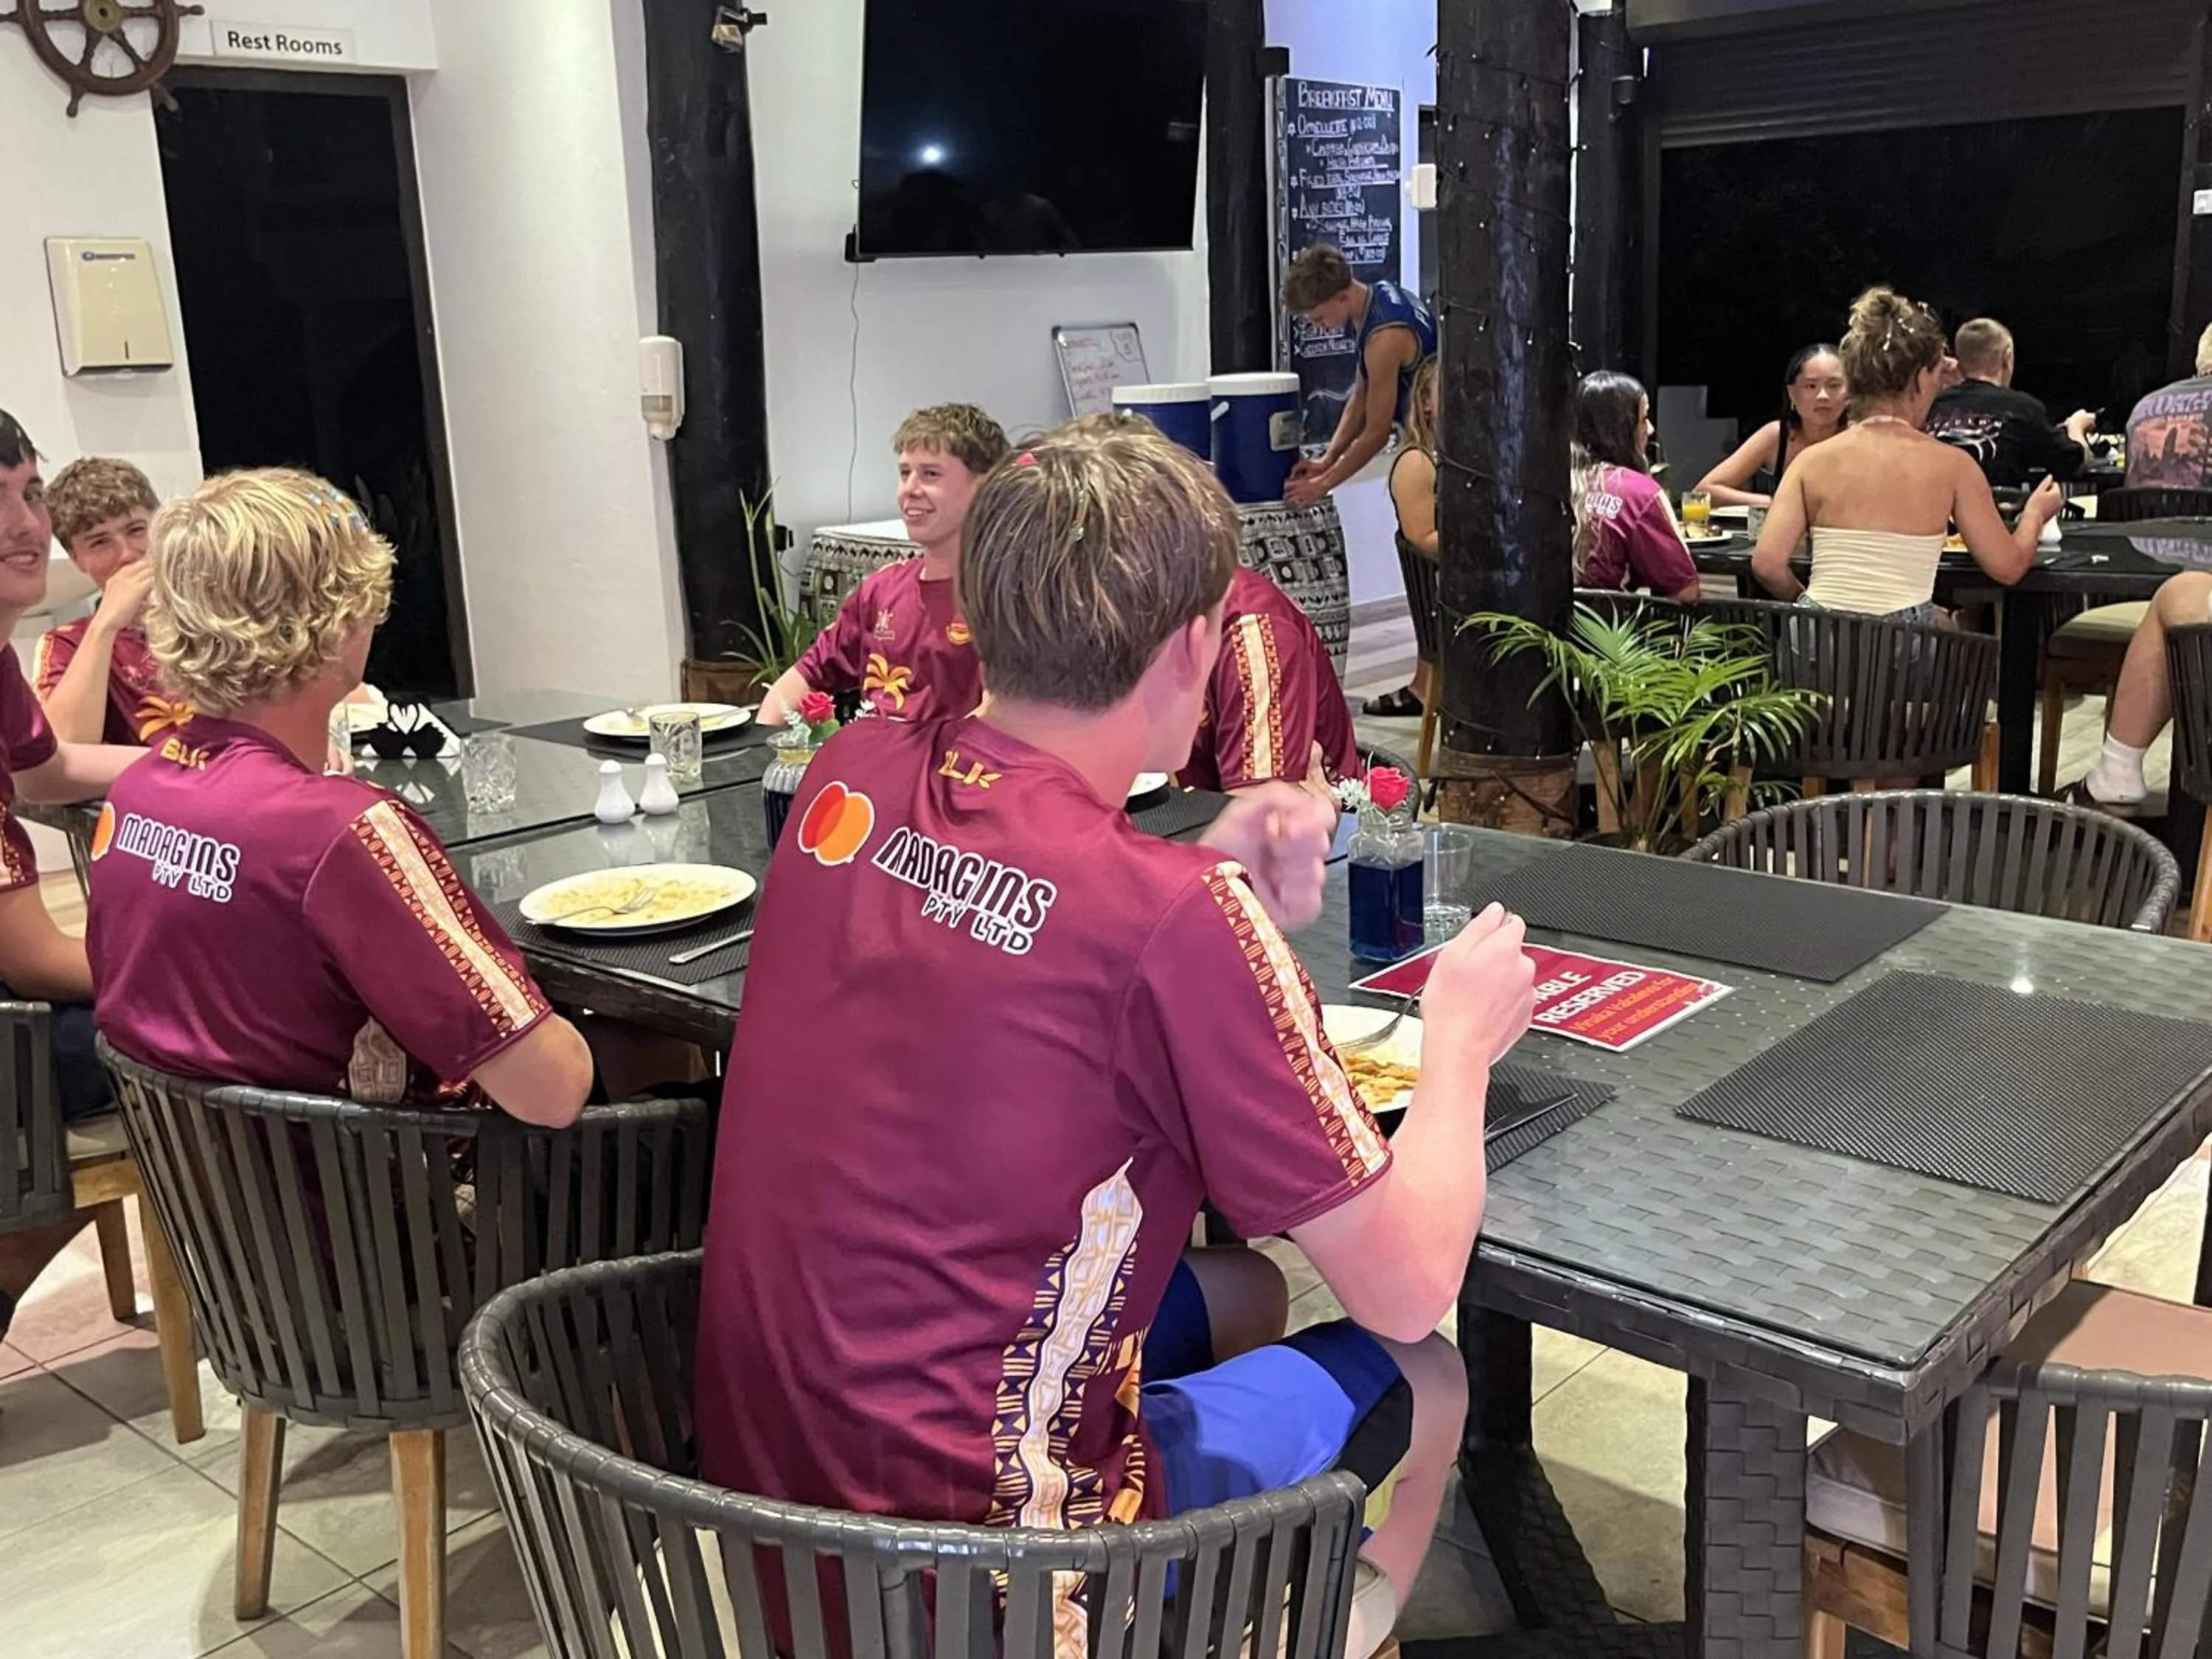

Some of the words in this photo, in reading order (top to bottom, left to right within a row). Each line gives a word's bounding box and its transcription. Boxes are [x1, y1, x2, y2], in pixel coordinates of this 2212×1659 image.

[227, 30, 271, 51] Rest
[275, 34, 343, 55] Rooms
[117, 814, 239, 884] MADAGINS
[153, 860, 183, 887] PTY
[189, 876, 231, 902] LTD
[922, 896, 967, 928] PTY
[971, 915, 1033, 954] LTD
[1534, 971, 1646, 1023] RESERVED
[1535, 970, 1593, 1004] ABLE
